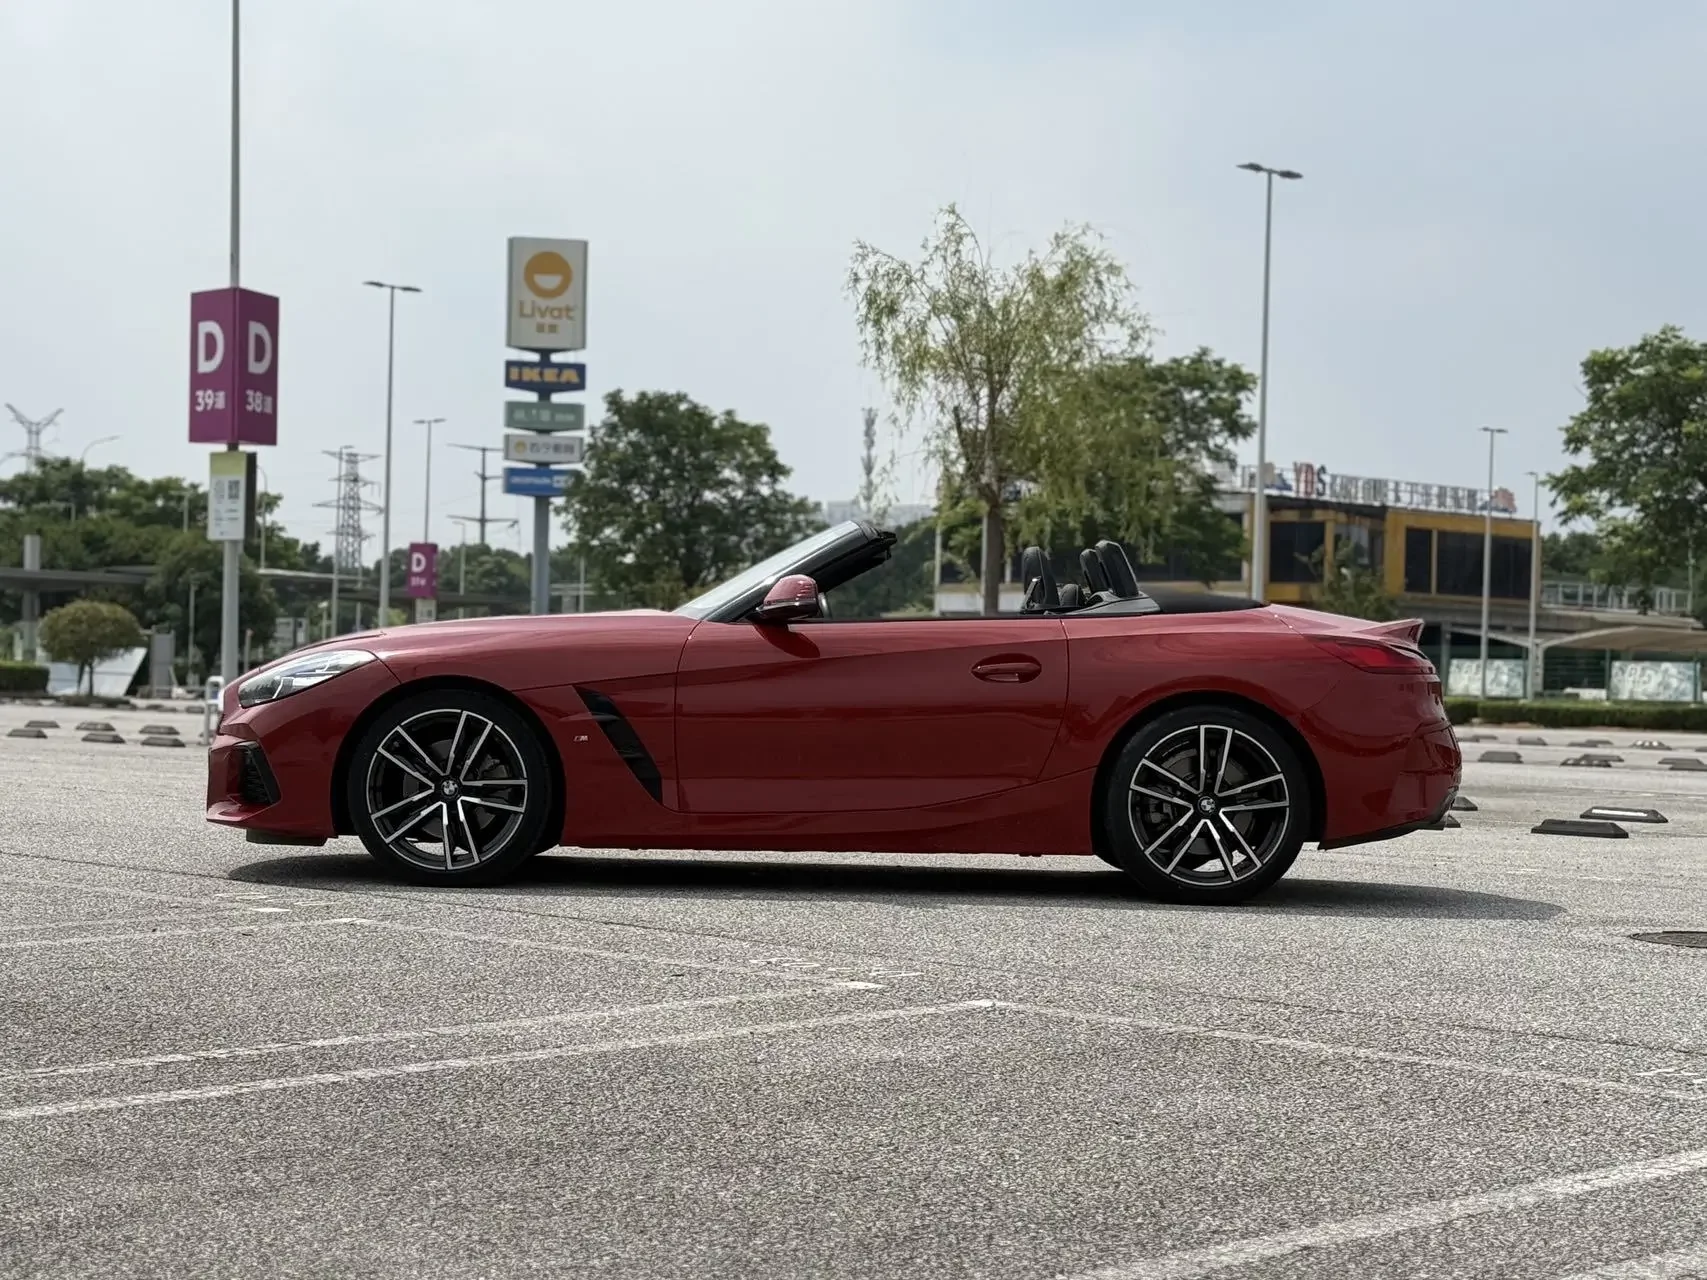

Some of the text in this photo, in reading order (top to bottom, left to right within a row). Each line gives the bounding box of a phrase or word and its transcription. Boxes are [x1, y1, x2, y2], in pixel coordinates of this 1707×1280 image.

[519, 299, 575, 320] Livat
[198, 320, 225, 374] D
[248, 320, 273, 374] D
[509, 366, 580, 383] IKEA
[411, 552, 426, 573] D
